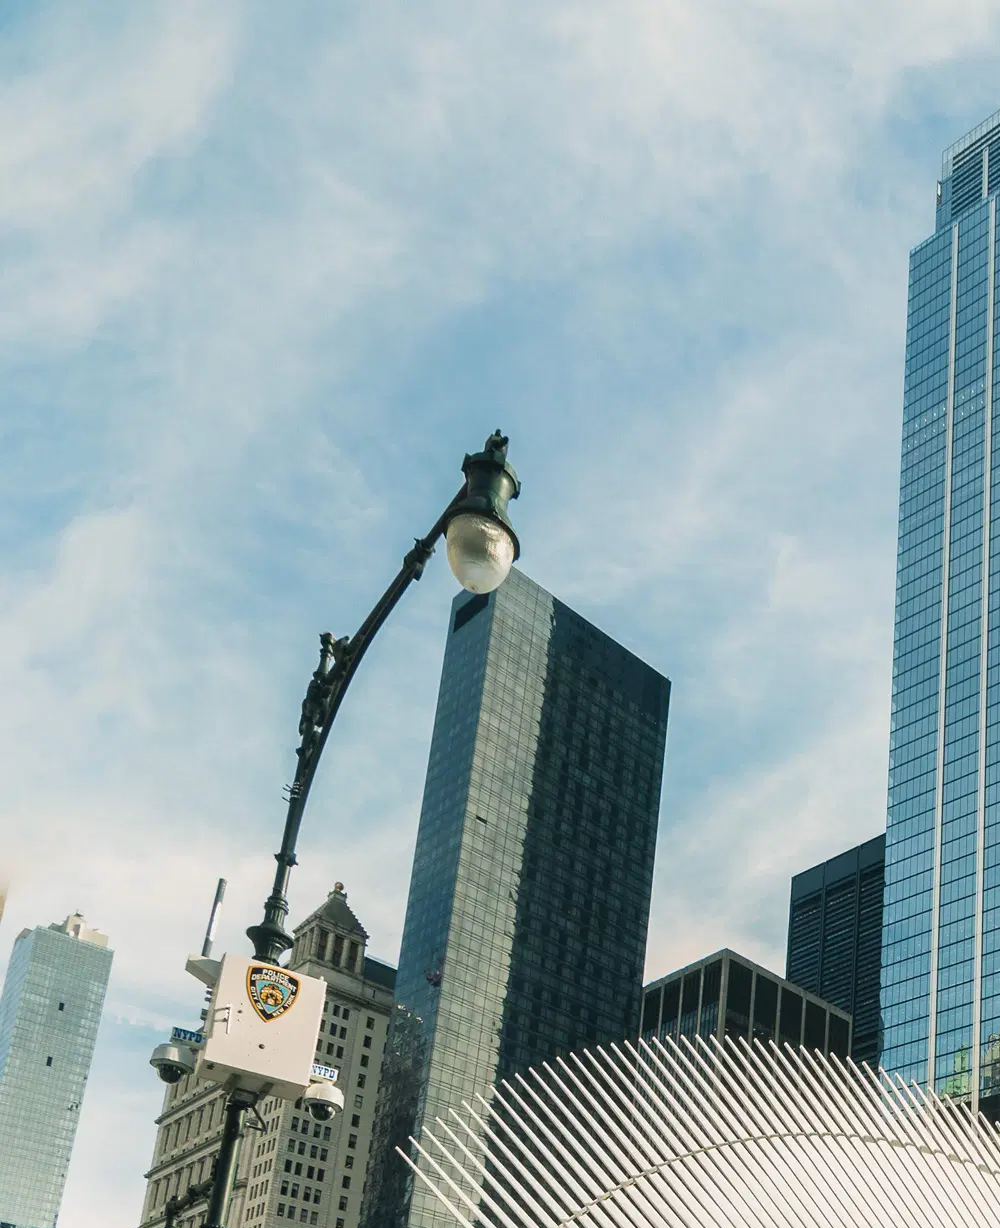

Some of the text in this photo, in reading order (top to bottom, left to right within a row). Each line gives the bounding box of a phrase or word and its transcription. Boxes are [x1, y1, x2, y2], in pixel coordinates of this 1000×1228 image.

[251, 973, 297, 992] DEPARTMENT
[262, 969, 289, 981] POLICE
[251, 986, 259, 1000] CITY
[272, 995, 295, 1017] NEW YORK
[174, 1027, 202, 1043] NYPD
